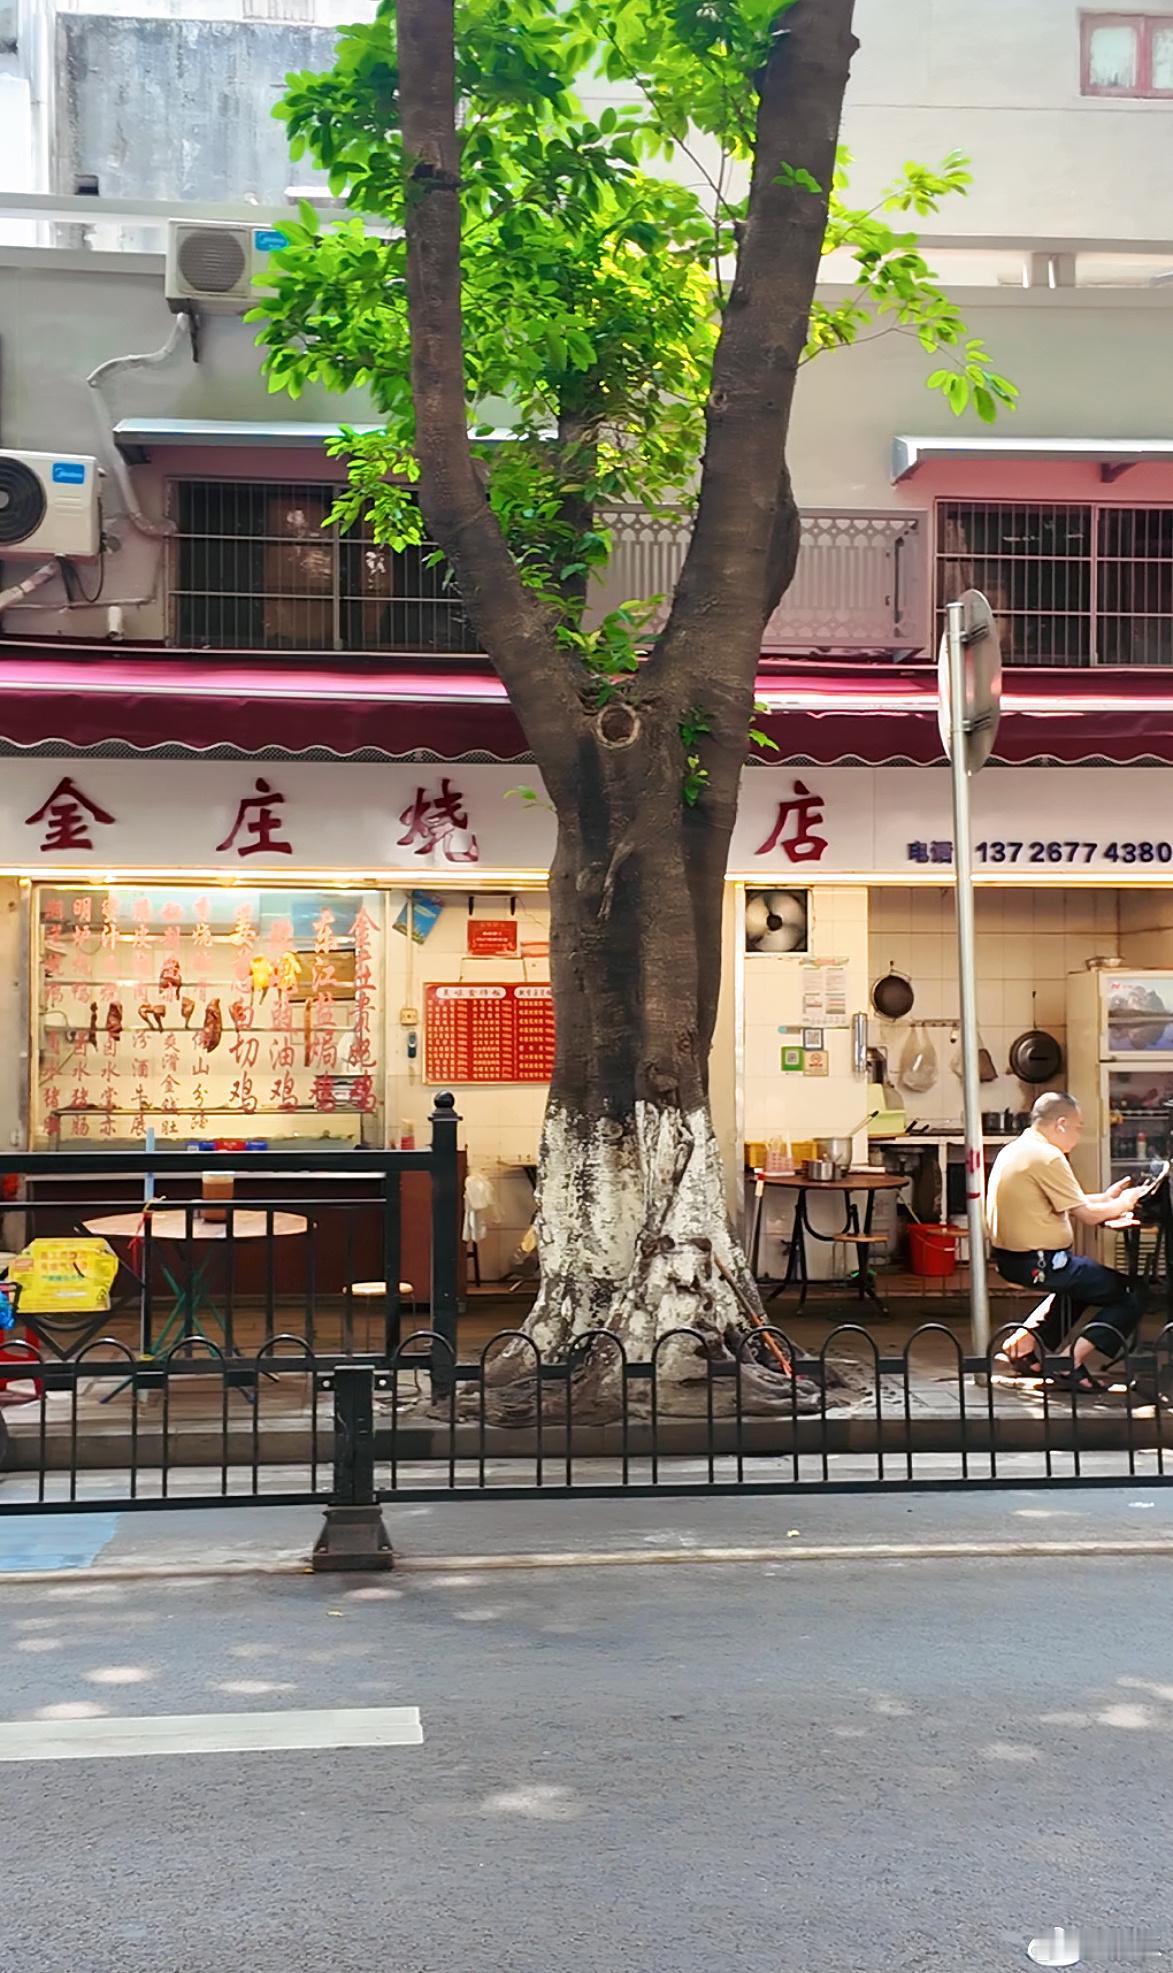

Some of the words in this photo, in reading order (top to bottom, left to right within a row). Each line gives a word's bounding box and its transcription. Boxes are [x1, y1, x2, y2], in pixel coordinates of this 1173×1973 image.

[25, 776, 829, 864] 金庄烧店
[976, 842, 1023, 863] 137
[1029, 842, 1098, 863] 2677
[1103, 842, 1172, 863] 4380
